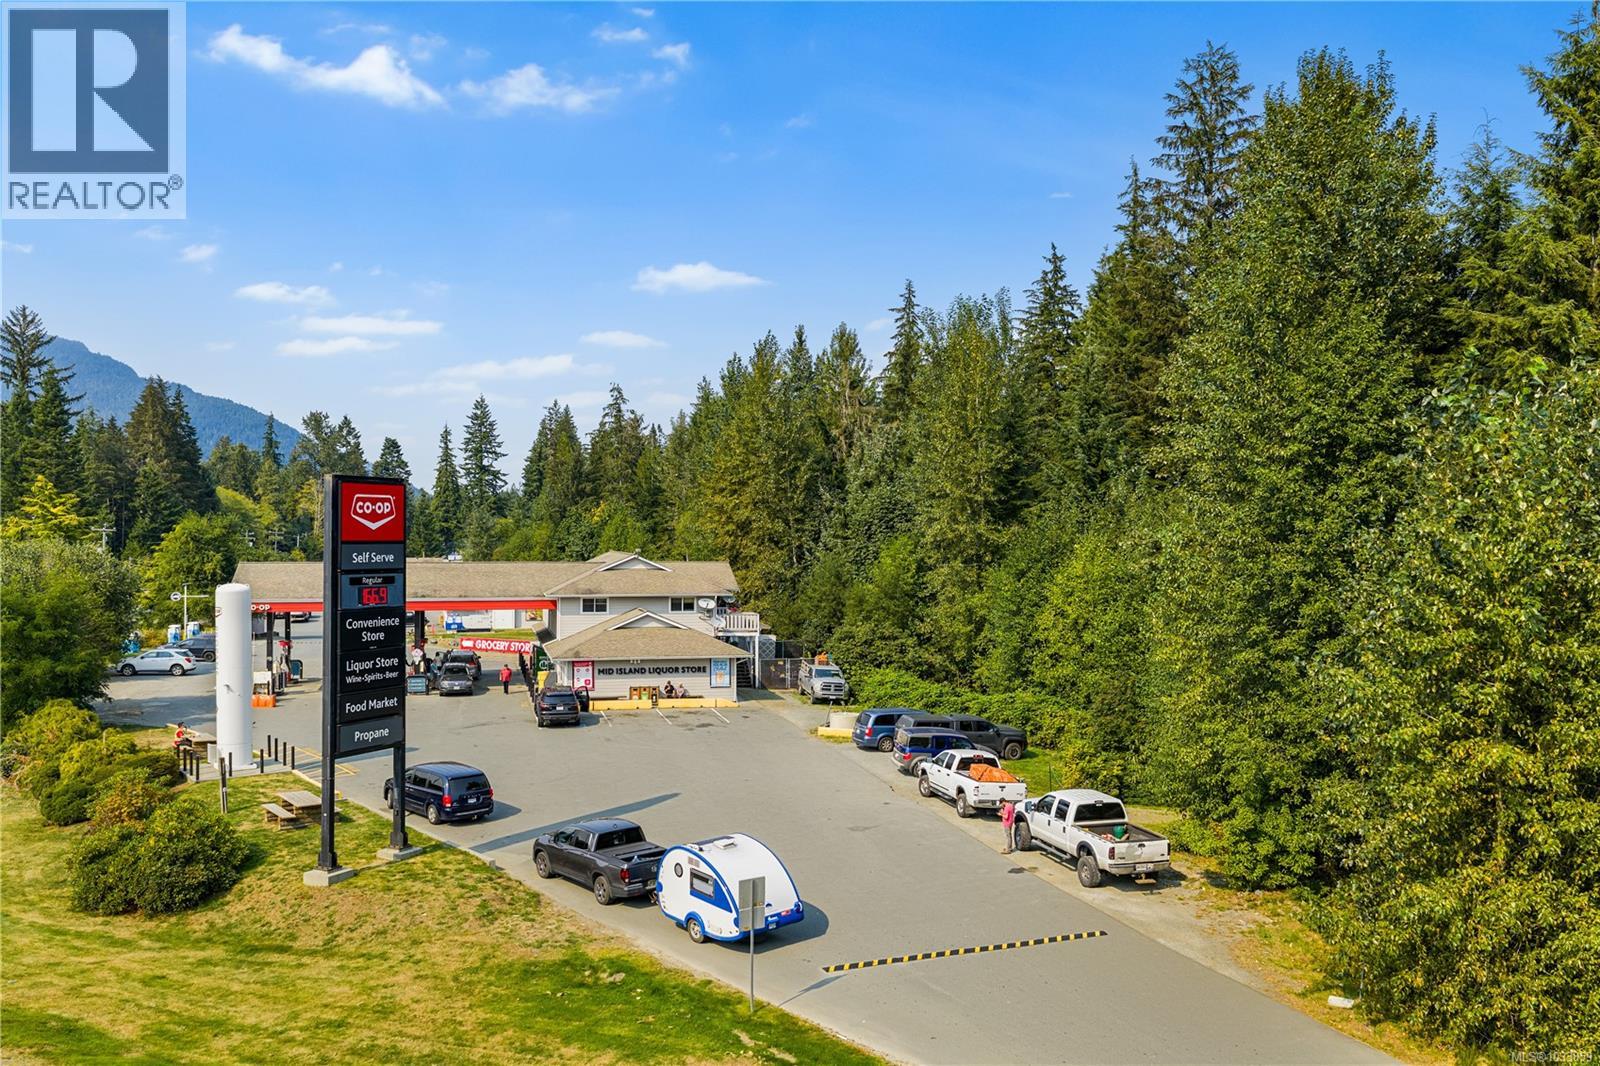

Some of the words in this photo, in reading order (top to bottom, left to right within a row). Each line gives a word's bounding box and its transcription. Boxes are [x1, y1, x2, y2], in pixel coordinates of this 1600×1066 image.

[352, 552, 369, 563] Self
[371, 552, 394, 563] Serve
[362, 577, 382, 585] Regular
[346, 617, 400, 629] Convenience
[362, 631, 385, 641] Store
[475, 640, 508, 651] GROCERY
[346, 660, 374, 673] Liquor
[376, 657, 399, 668] Store
[616, 667, 647, 675] ISLAND
[648, 666, 680, 675] LIQUOR
[345, 701, 367, 713] Food
[368, 697, 398, 710] Market
[354, 727, 389, 742] Propane
